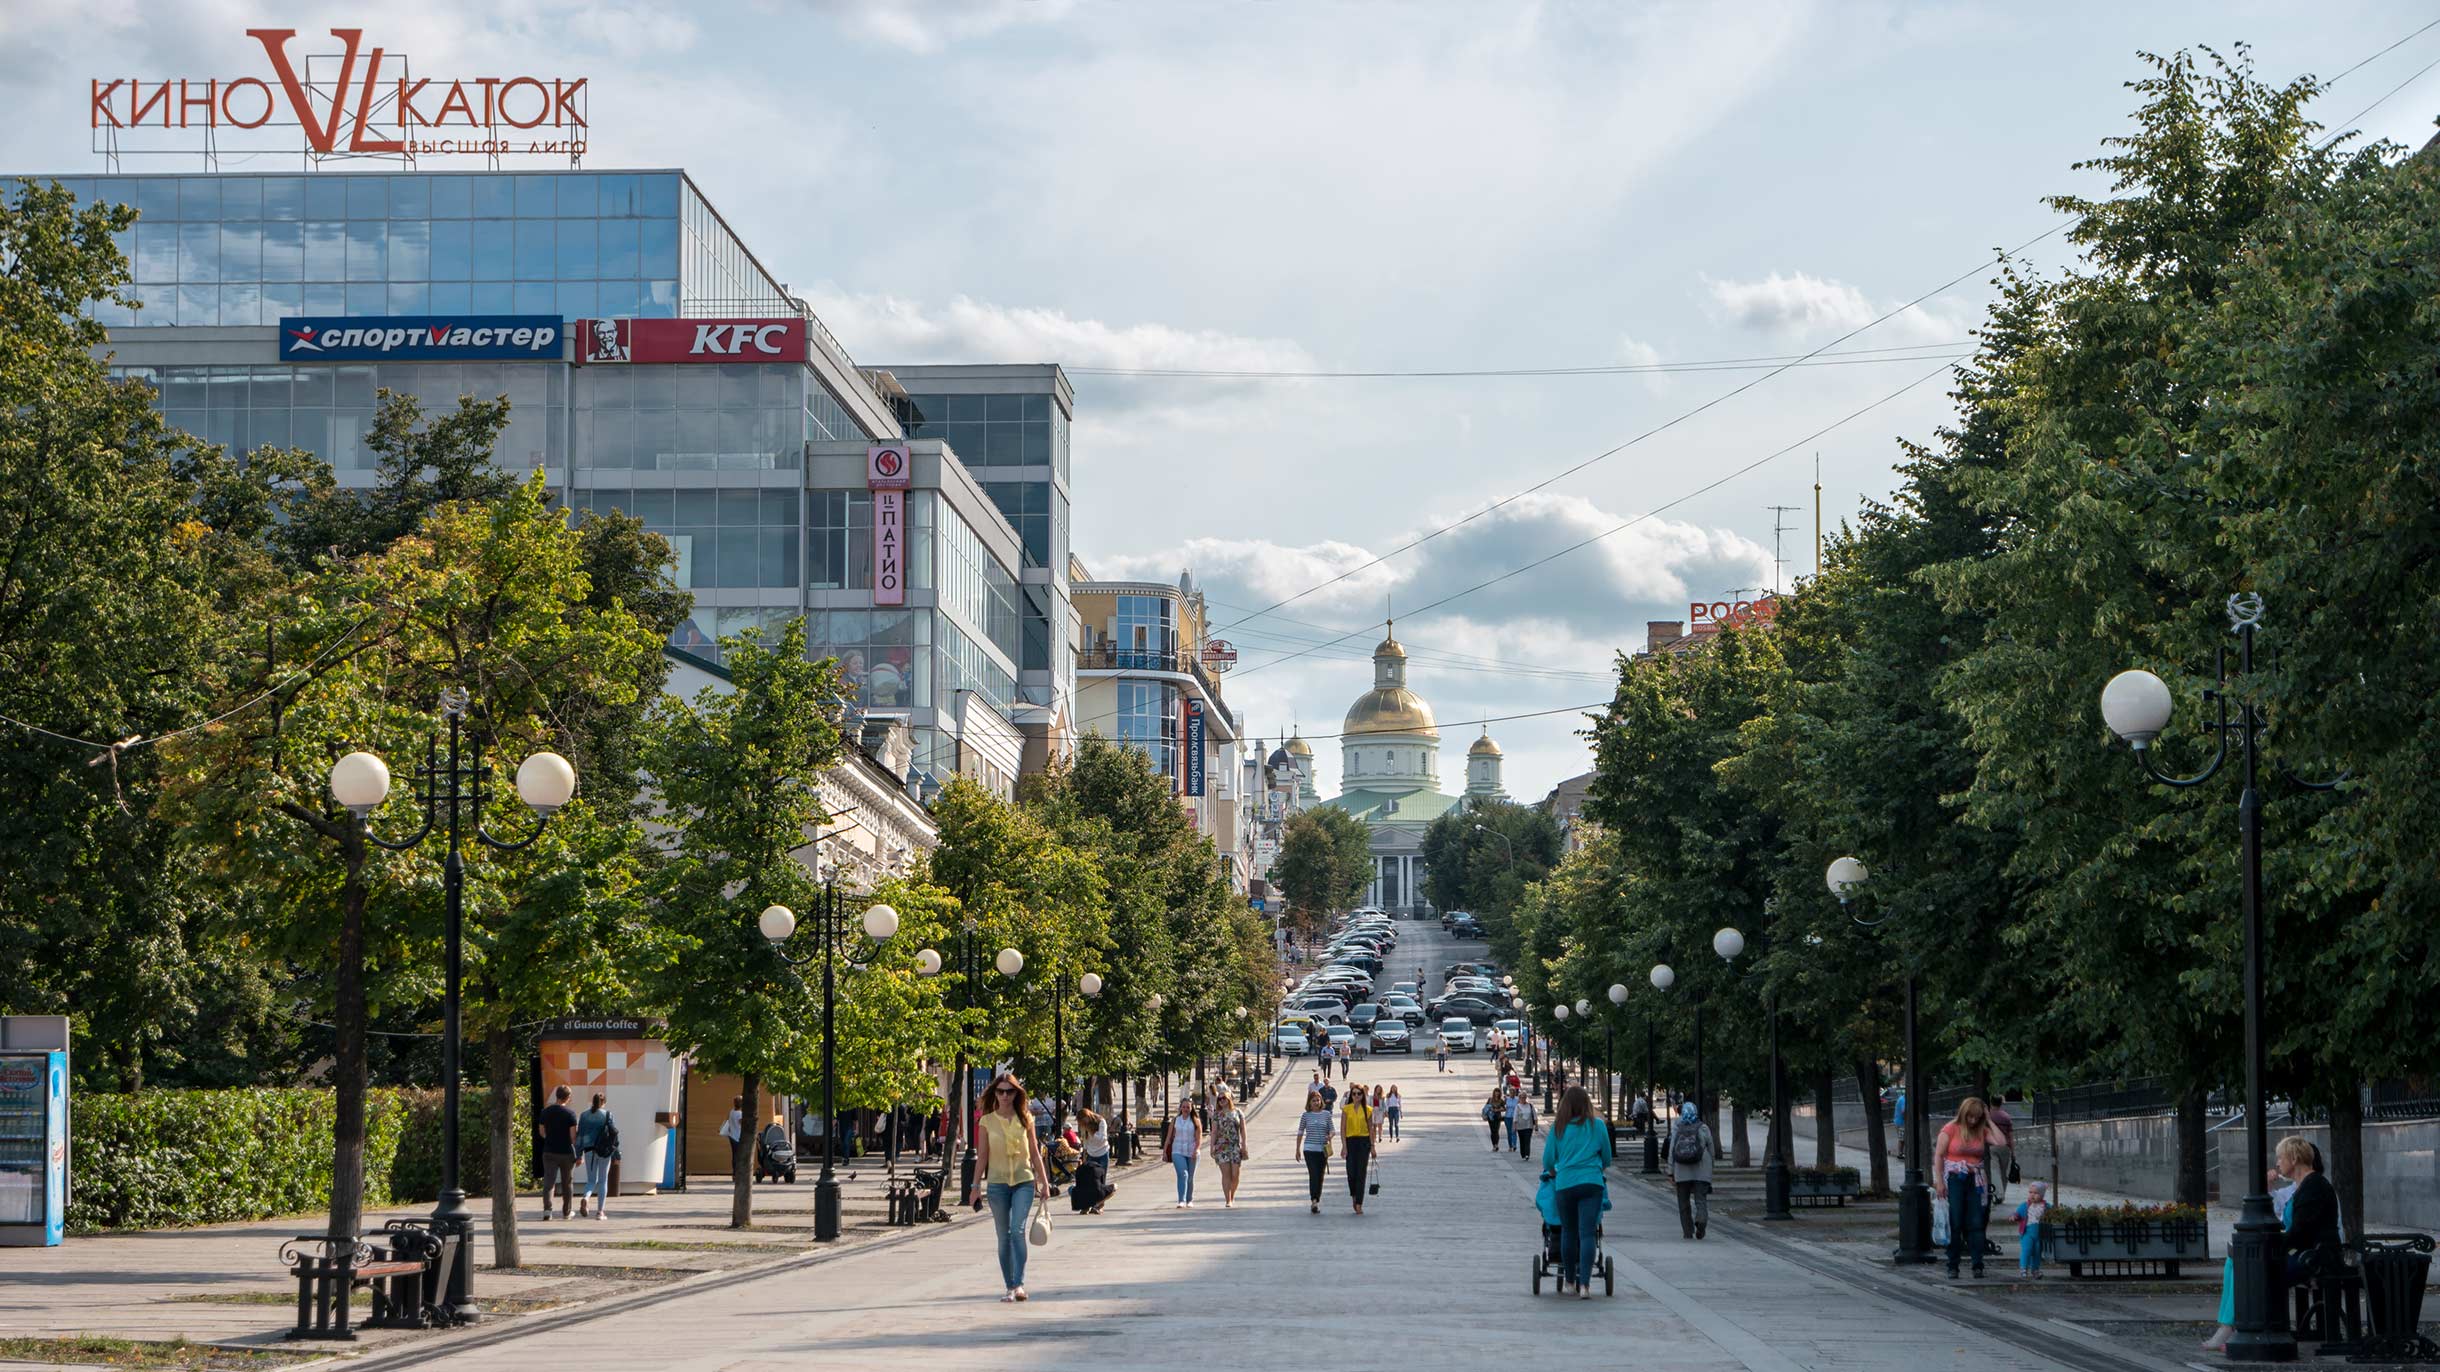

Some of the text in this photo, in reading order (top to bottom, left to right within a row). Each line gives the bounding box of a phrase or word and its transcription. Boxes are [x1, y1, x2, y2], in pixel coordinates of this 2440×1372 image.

[91, 28, 589, 152] КИНО VL КАТОК
[689, 324, 789, 355] KFC
[881, 511, 897, 590] ПАТИО
[1189, 718, 1201, 794] Промсвязьбанк
[605, 1019, 639, 1030] Coffee
